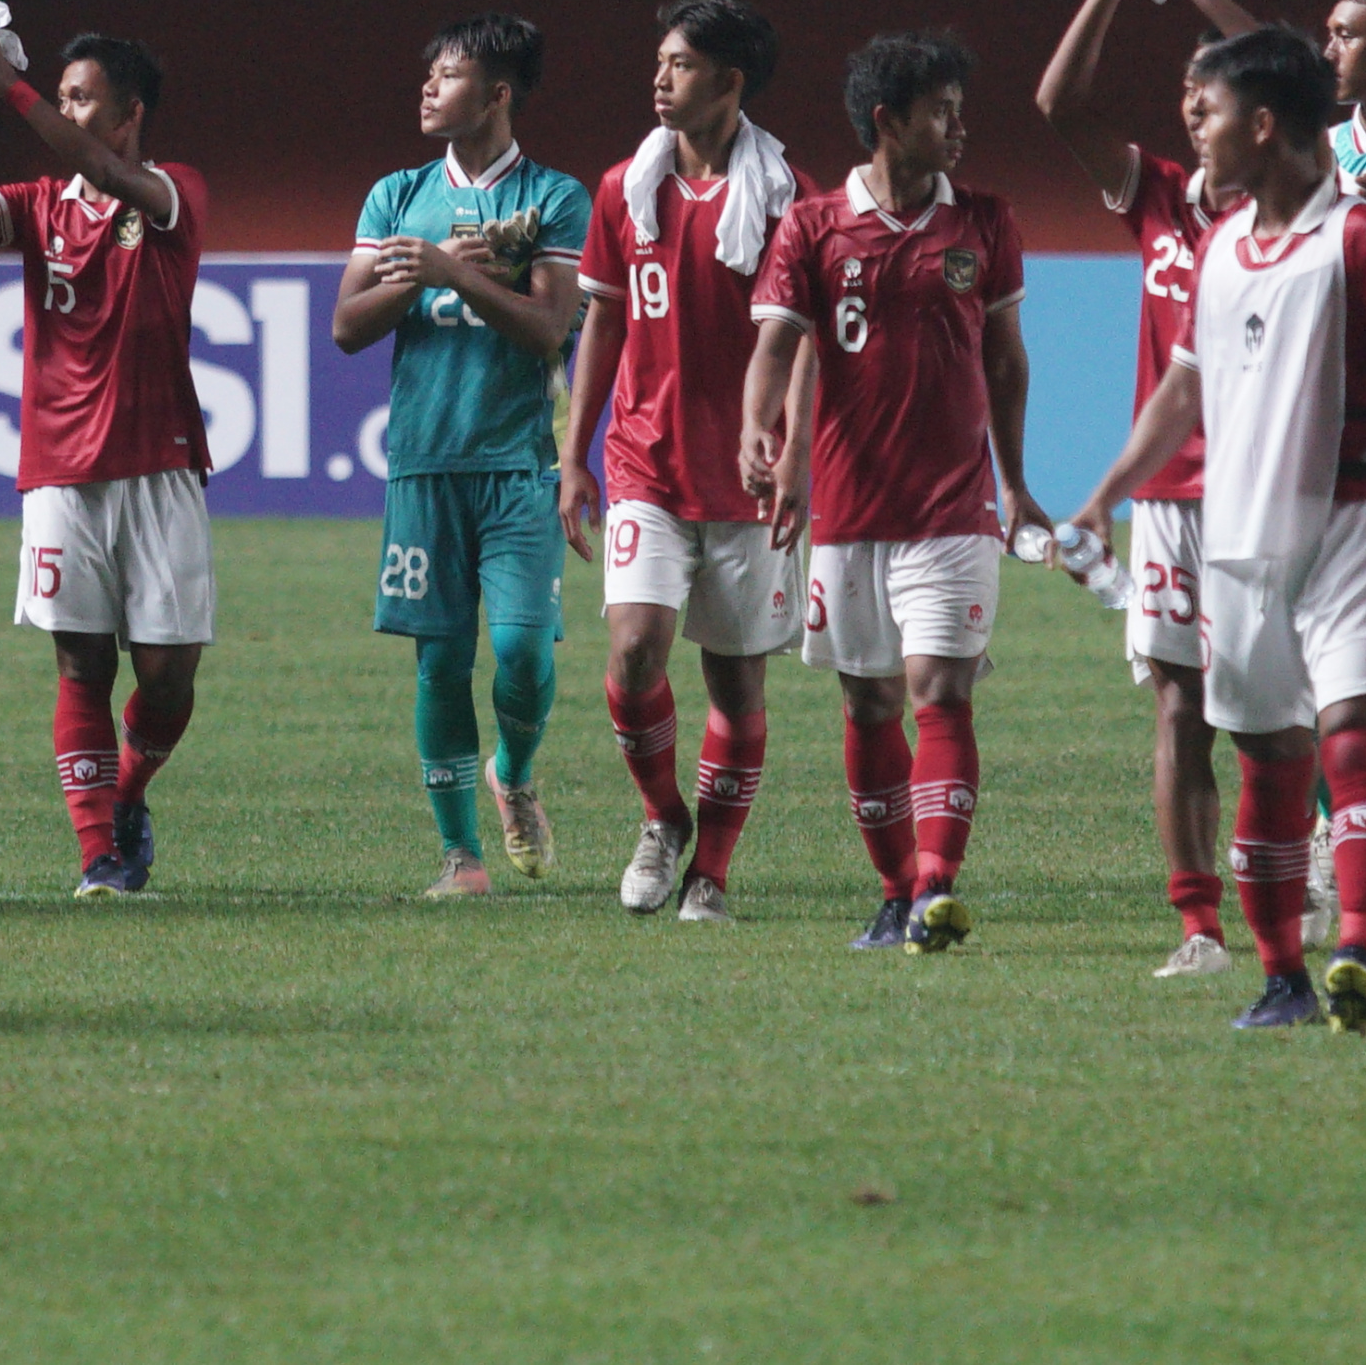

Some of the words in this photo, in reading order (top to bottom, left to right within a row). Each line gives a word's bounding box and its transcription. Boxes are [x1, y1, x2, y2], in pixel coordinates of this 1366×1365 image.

[629, 262, 669, 321] 19
[1145, 234, 1194, 303] 25
[835, 296, 868, 353] 6
[31, 547, 63, 598] 15
[380, 544, 429, 600] 28
[606, 519, 640, 573] 19
[806, 578, 827, 632] 6
[1142, 561, 1197, 625] 25
